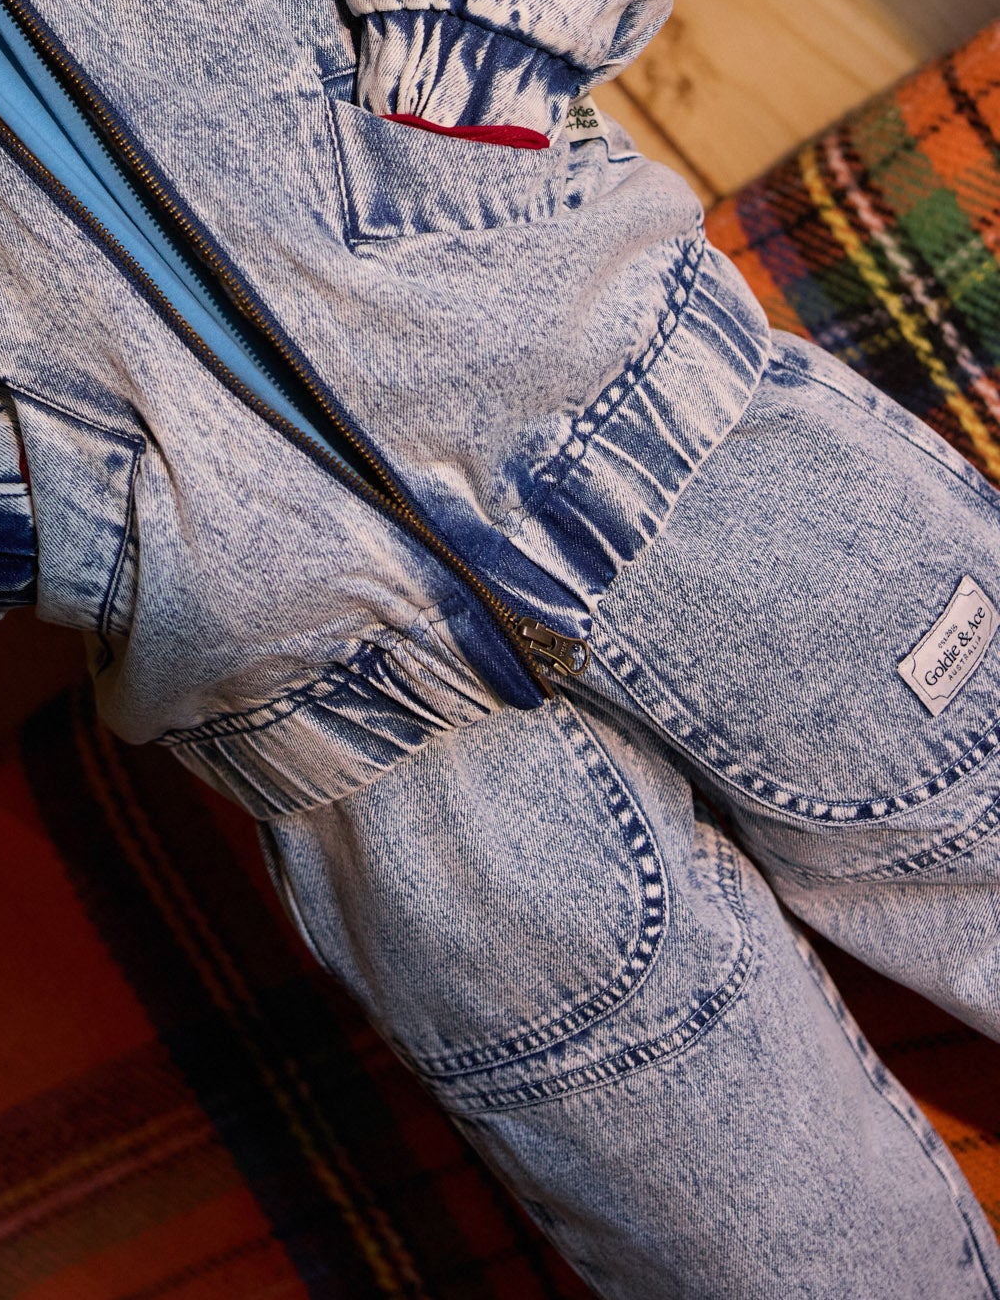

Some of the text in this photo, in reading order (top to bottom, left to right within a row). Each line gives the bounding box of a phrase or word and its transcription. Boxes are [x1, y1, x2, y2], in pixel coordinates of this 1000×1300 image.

[566, 105, 595, 119] oldie
[924, 606, 986, 686] Goldie & Ace
[948, 635, 982, 680] AUSTRALIA
